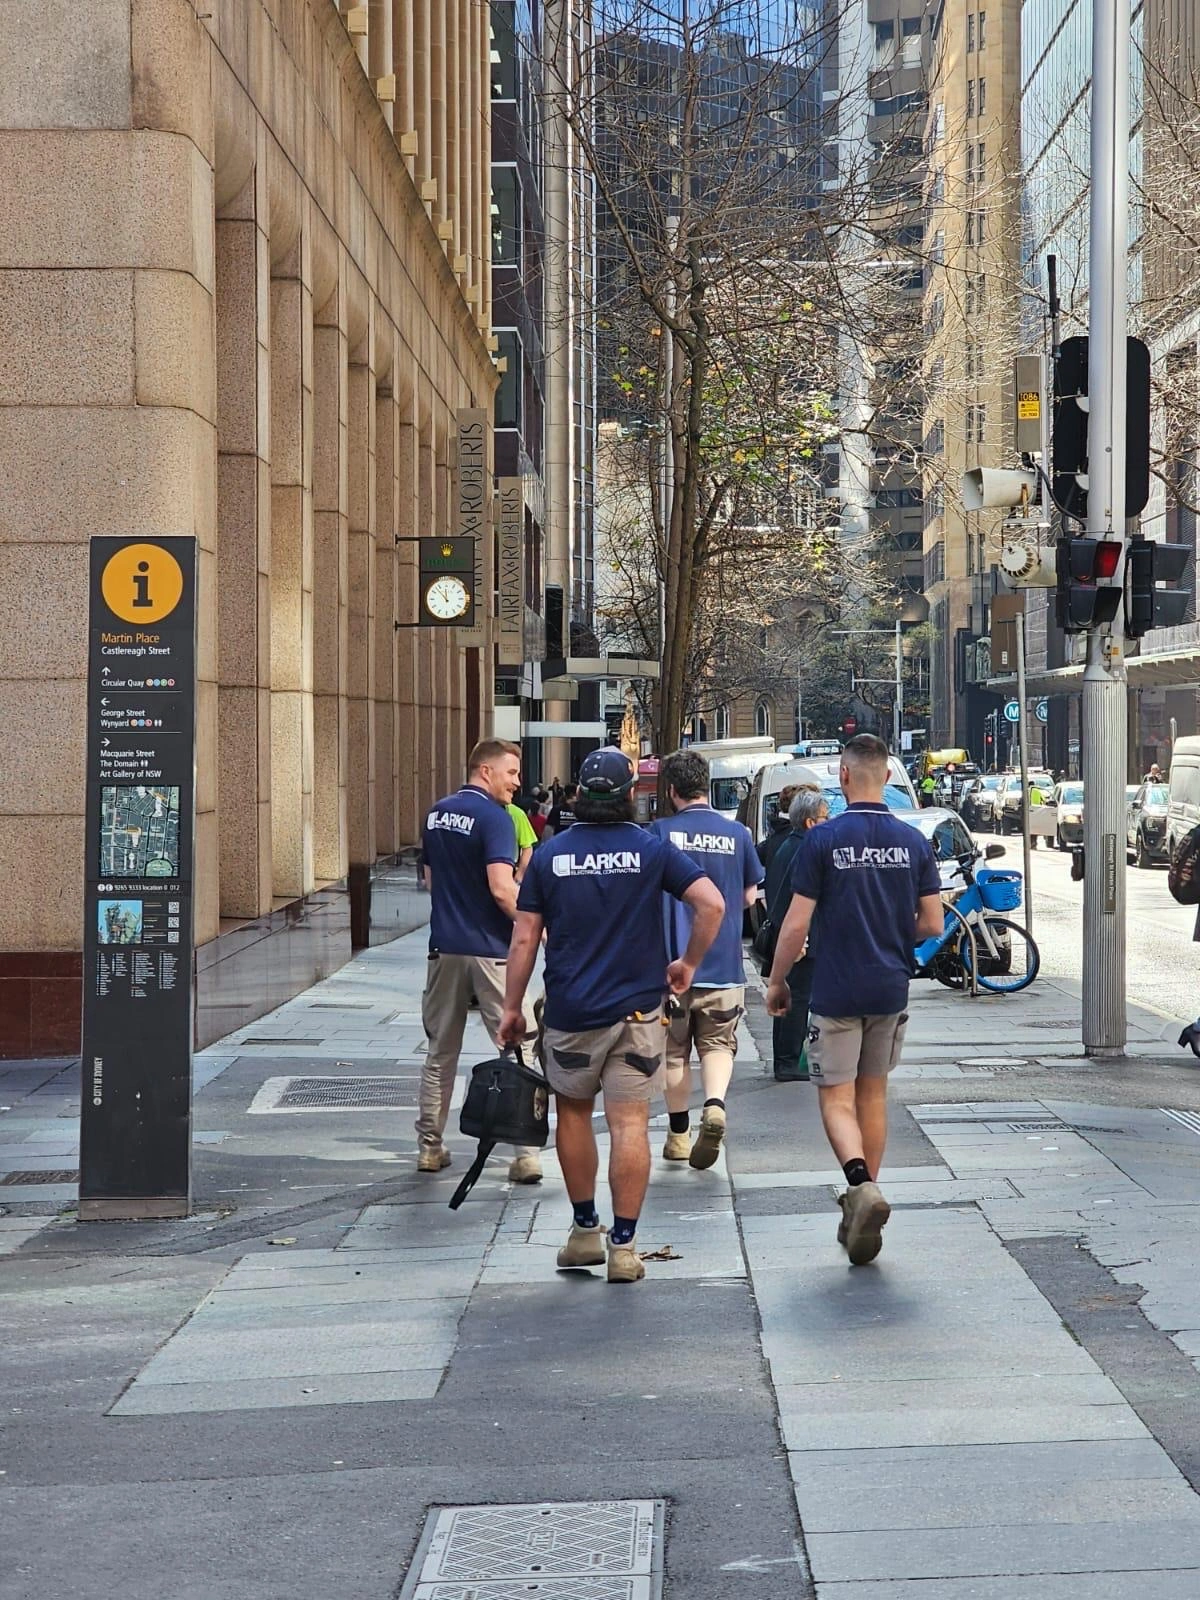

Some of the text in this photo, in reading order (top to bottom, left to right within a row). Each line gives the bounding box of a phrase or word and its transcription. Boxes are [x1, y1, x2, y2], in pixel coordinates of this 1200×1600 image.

[101, 632, 160, 643] Martin Place
[101, 645, 170, 656] Castlereagh Street
[101, 679, 144, 688] Circular Quay
[100, 709, 145, 718] George Street
[100, 719, 129, 728] Wynyard
[100, 749, 155, 759] Macquarie Street
[100, 759, 139, 767] The Domain
[99, 769, 162, 780] Art Gallery of NSW
[435, 811, 475, 831] LARKIN
[683, 832, 735, 851] LARKIN
[570, 851, 640, 870] LARKIN
[849, 846, 910, 864] LARKIN
